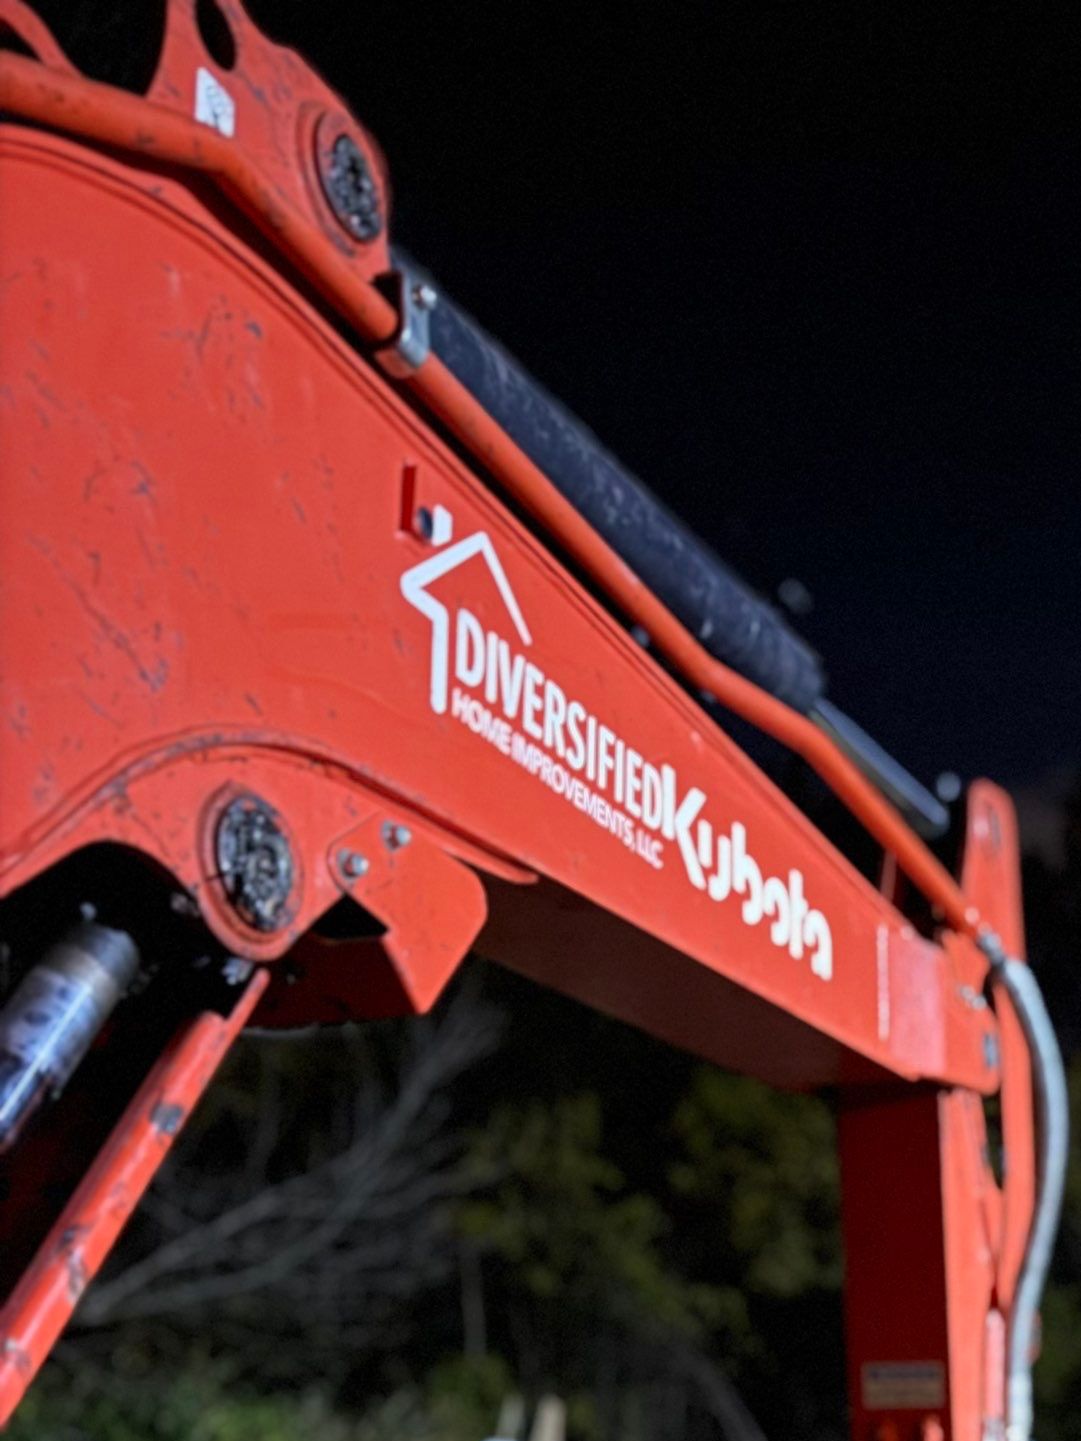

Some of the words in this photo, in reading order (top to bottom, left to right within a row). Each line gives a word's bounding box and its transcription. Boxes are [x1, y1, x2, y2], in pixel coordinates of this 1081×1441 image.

[451, 688, 512, 756] HOME
[635, 829, 663, 869] LLC
[456, 609, 662, 831] DIVERSIFIED
[661, 764, 832, 981] Kubota
